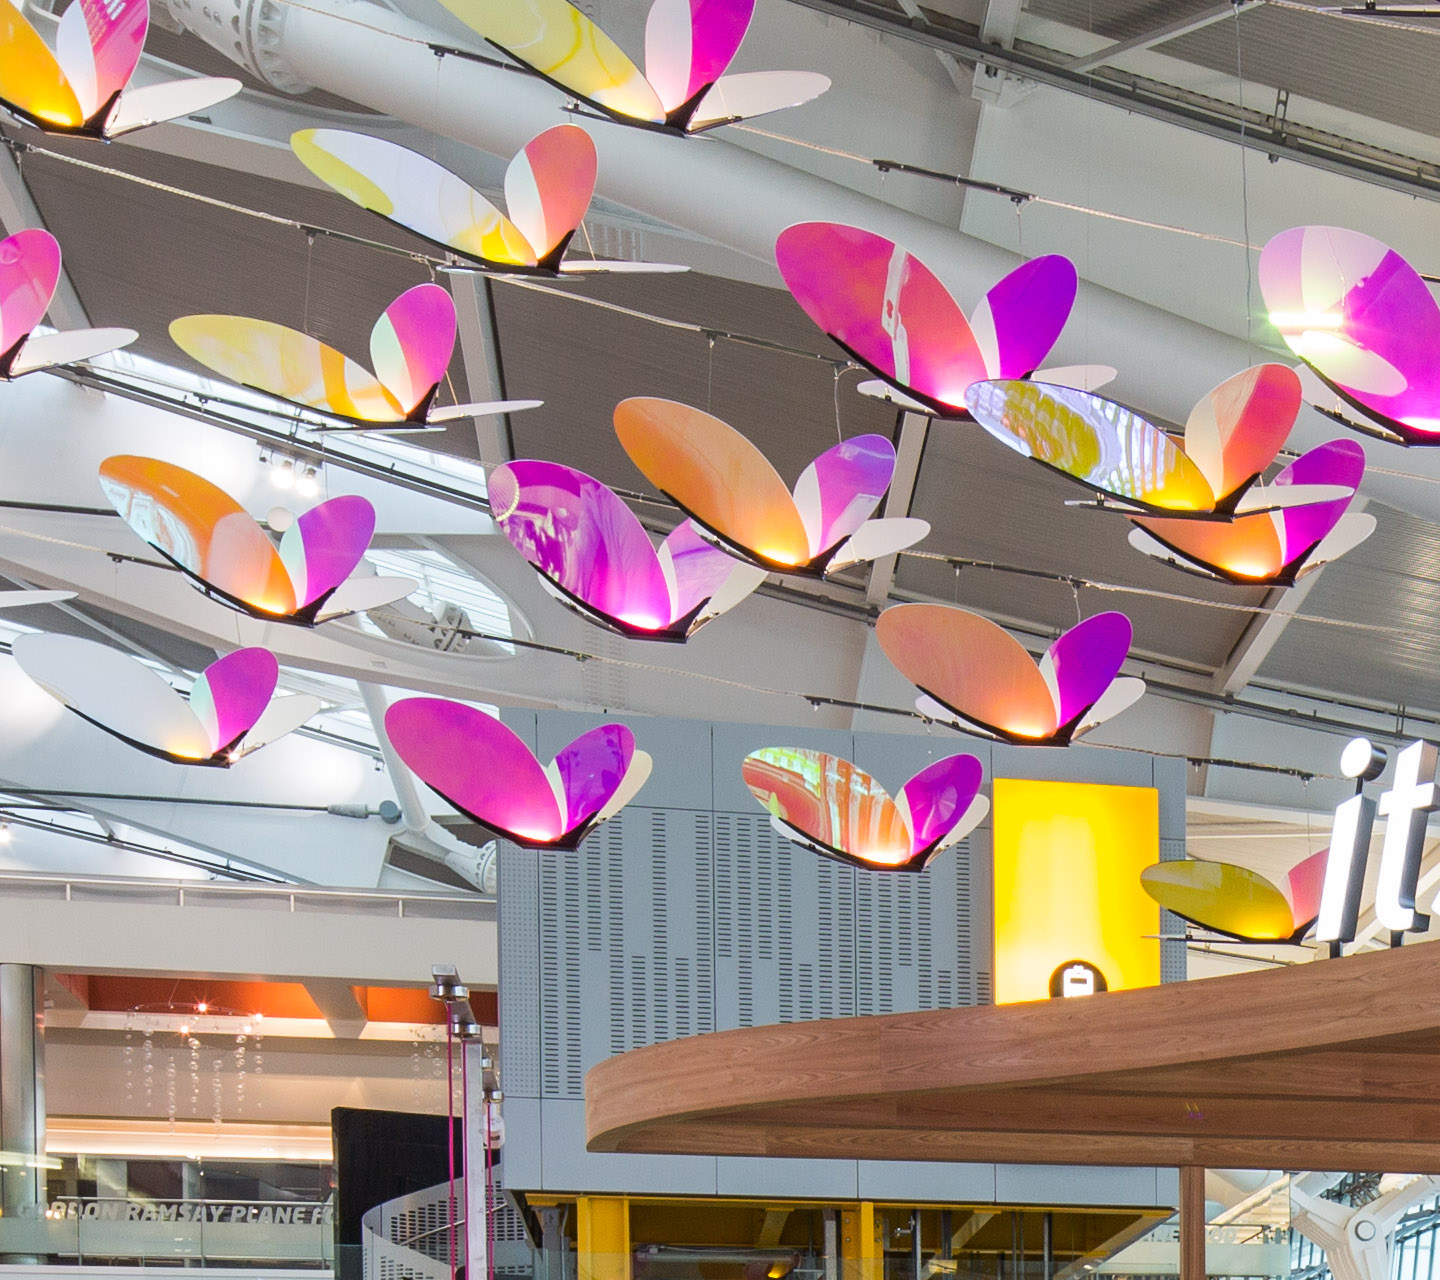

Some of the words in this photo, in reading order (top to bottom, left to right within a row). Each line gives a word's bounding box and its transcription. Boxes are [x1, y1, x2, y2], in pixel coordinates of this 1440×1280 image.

[17, 1201, 120, 1221] GORDON
[126, 1202, 223, 1223] RAMSAY
[229, 1205, 306, 1225] PLANE
